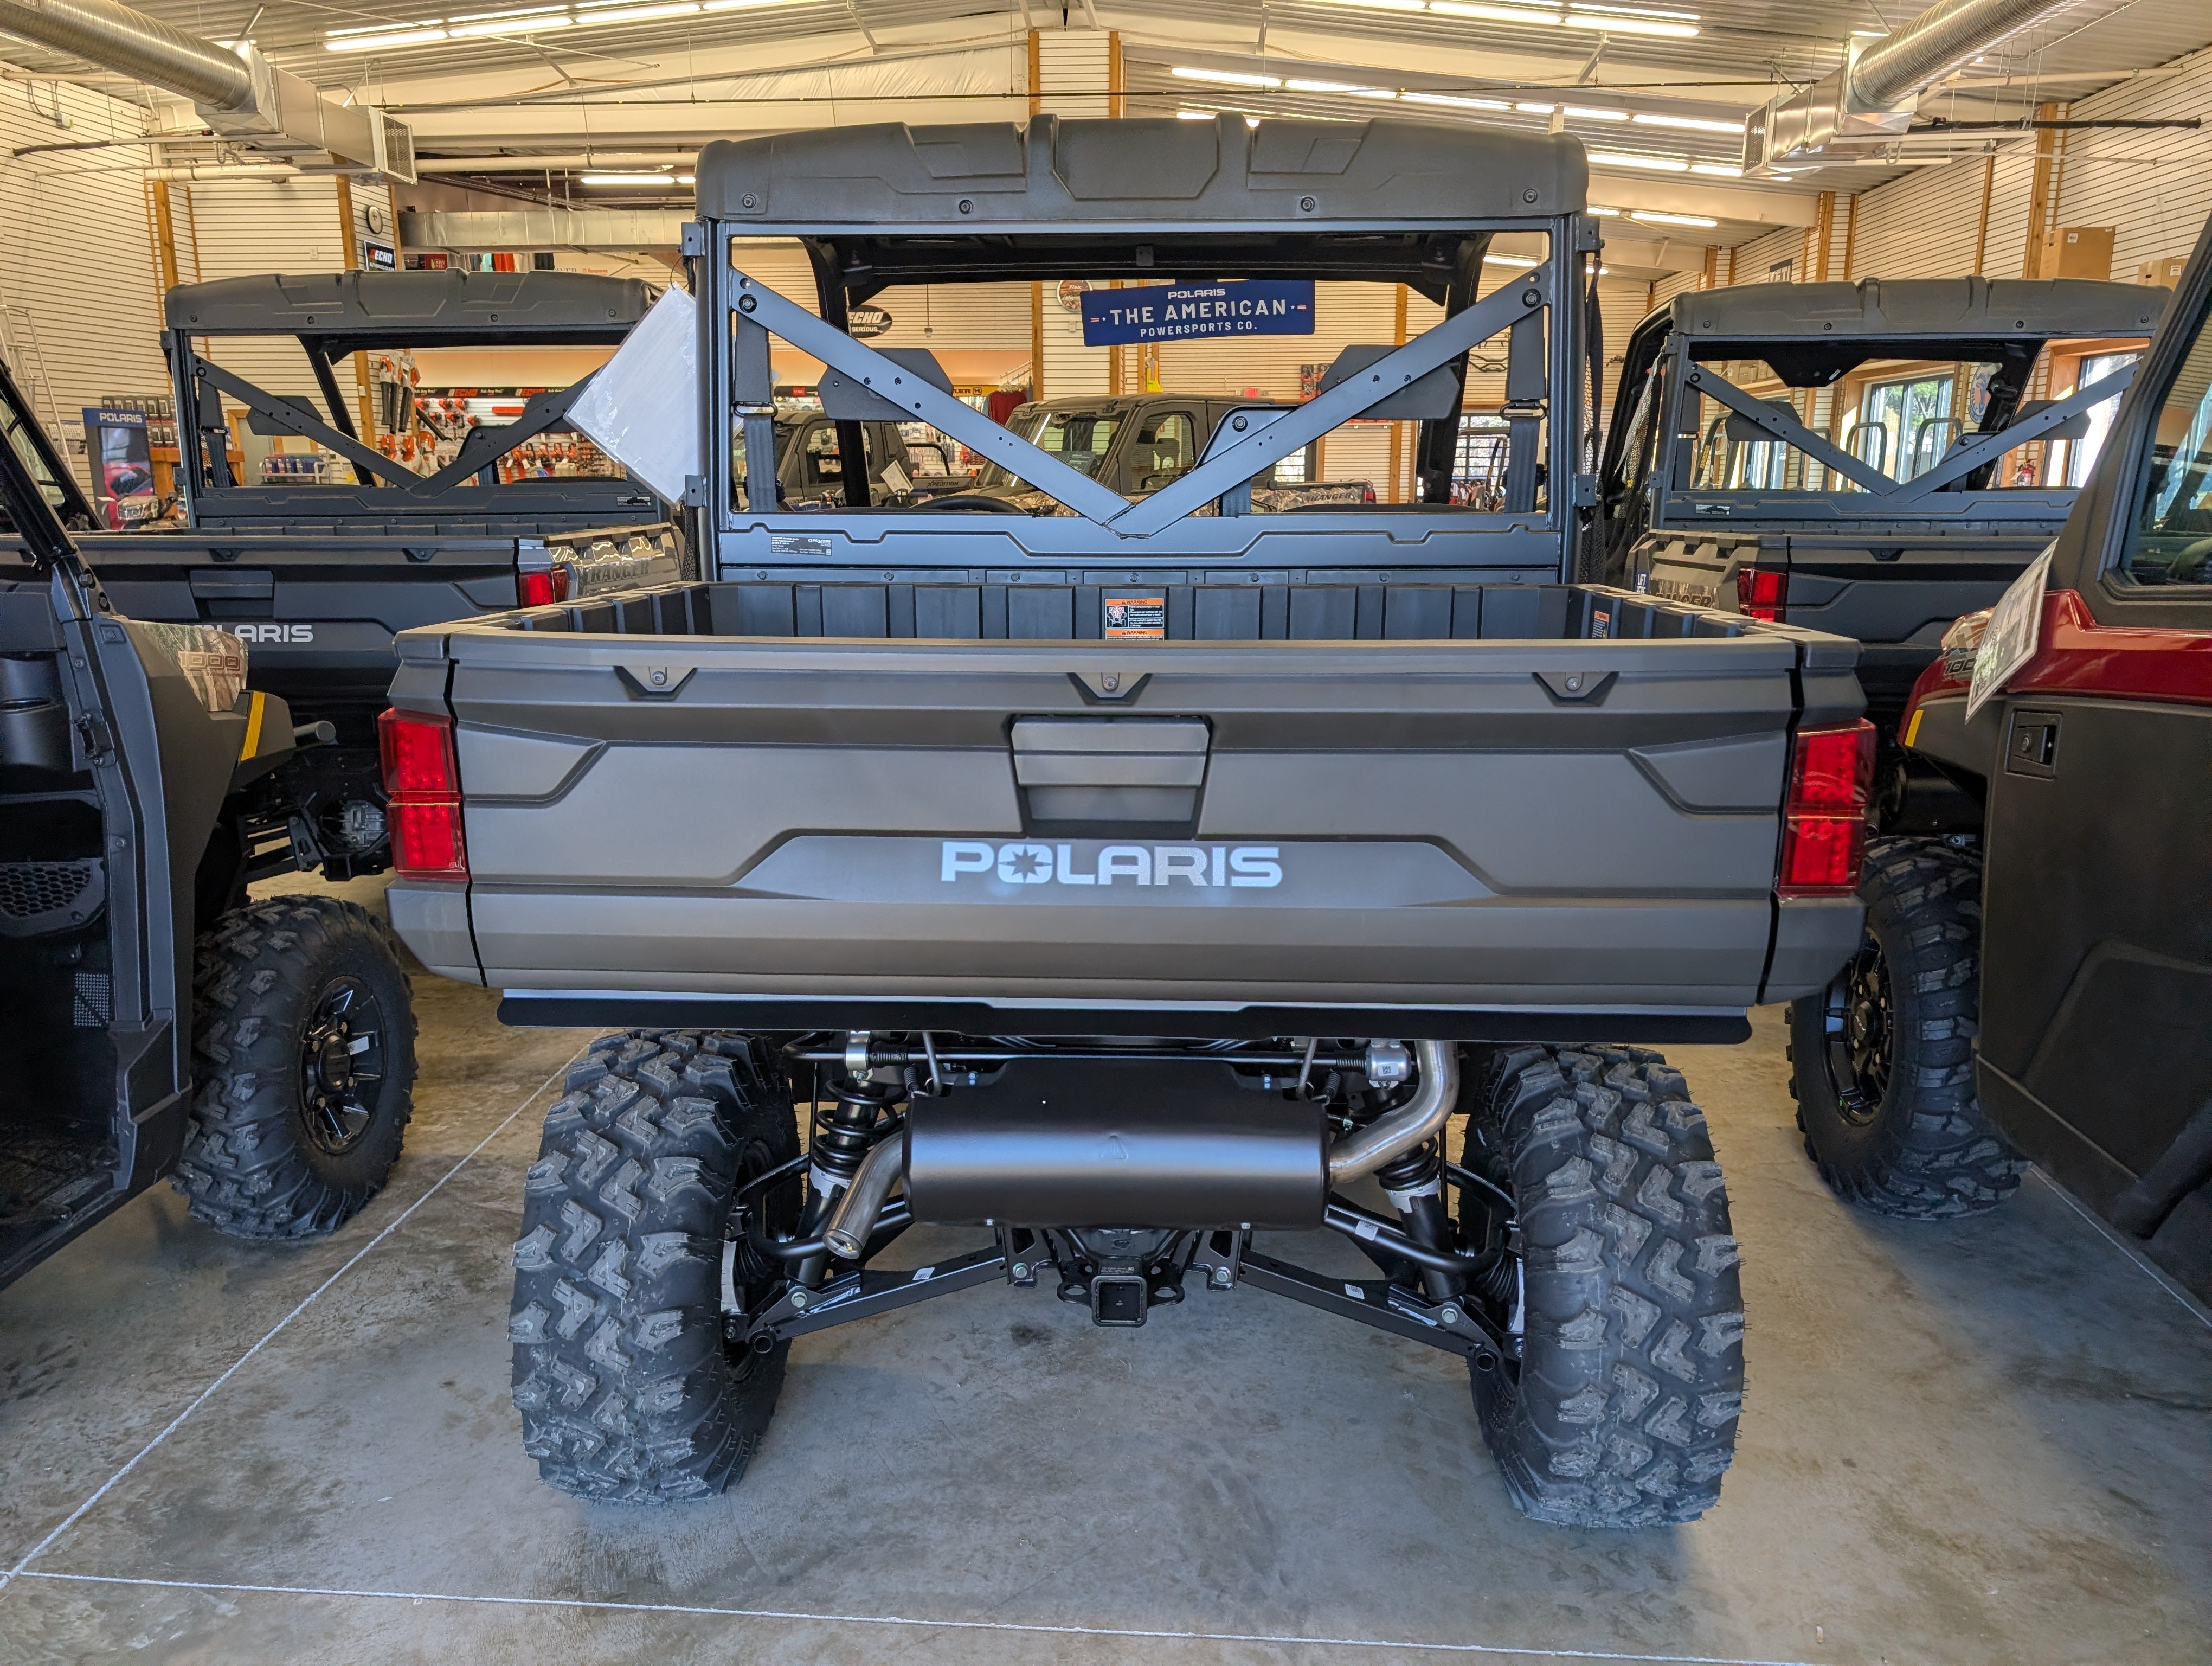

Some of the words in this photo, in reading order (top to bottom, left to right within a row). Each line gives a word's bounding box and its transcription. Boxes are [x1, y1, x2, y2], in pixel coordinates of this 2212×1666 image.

[375, 249, 393, 264] ECHO
[1168, 288, 1225, 299] POLARIS
[848, 311, 884, 324] ECHO
[1110, 306, 1154, 325] THE
[1165, 299, 1285, 321] AMERICAN
[1140, 321, 1231, 337] POWERSPORTS
[1237, 321, 1257, 330] CO.
[99, 412, 143, 424] POLARIS
[925, 480, 959, 488] XPEDITION
[590, 562, 649, 582] RANGER
[178, 651, 240, 671] 1000
[1944, 658, 1976, 674] 100
[941, 841, 1282, 888] POLARIS
